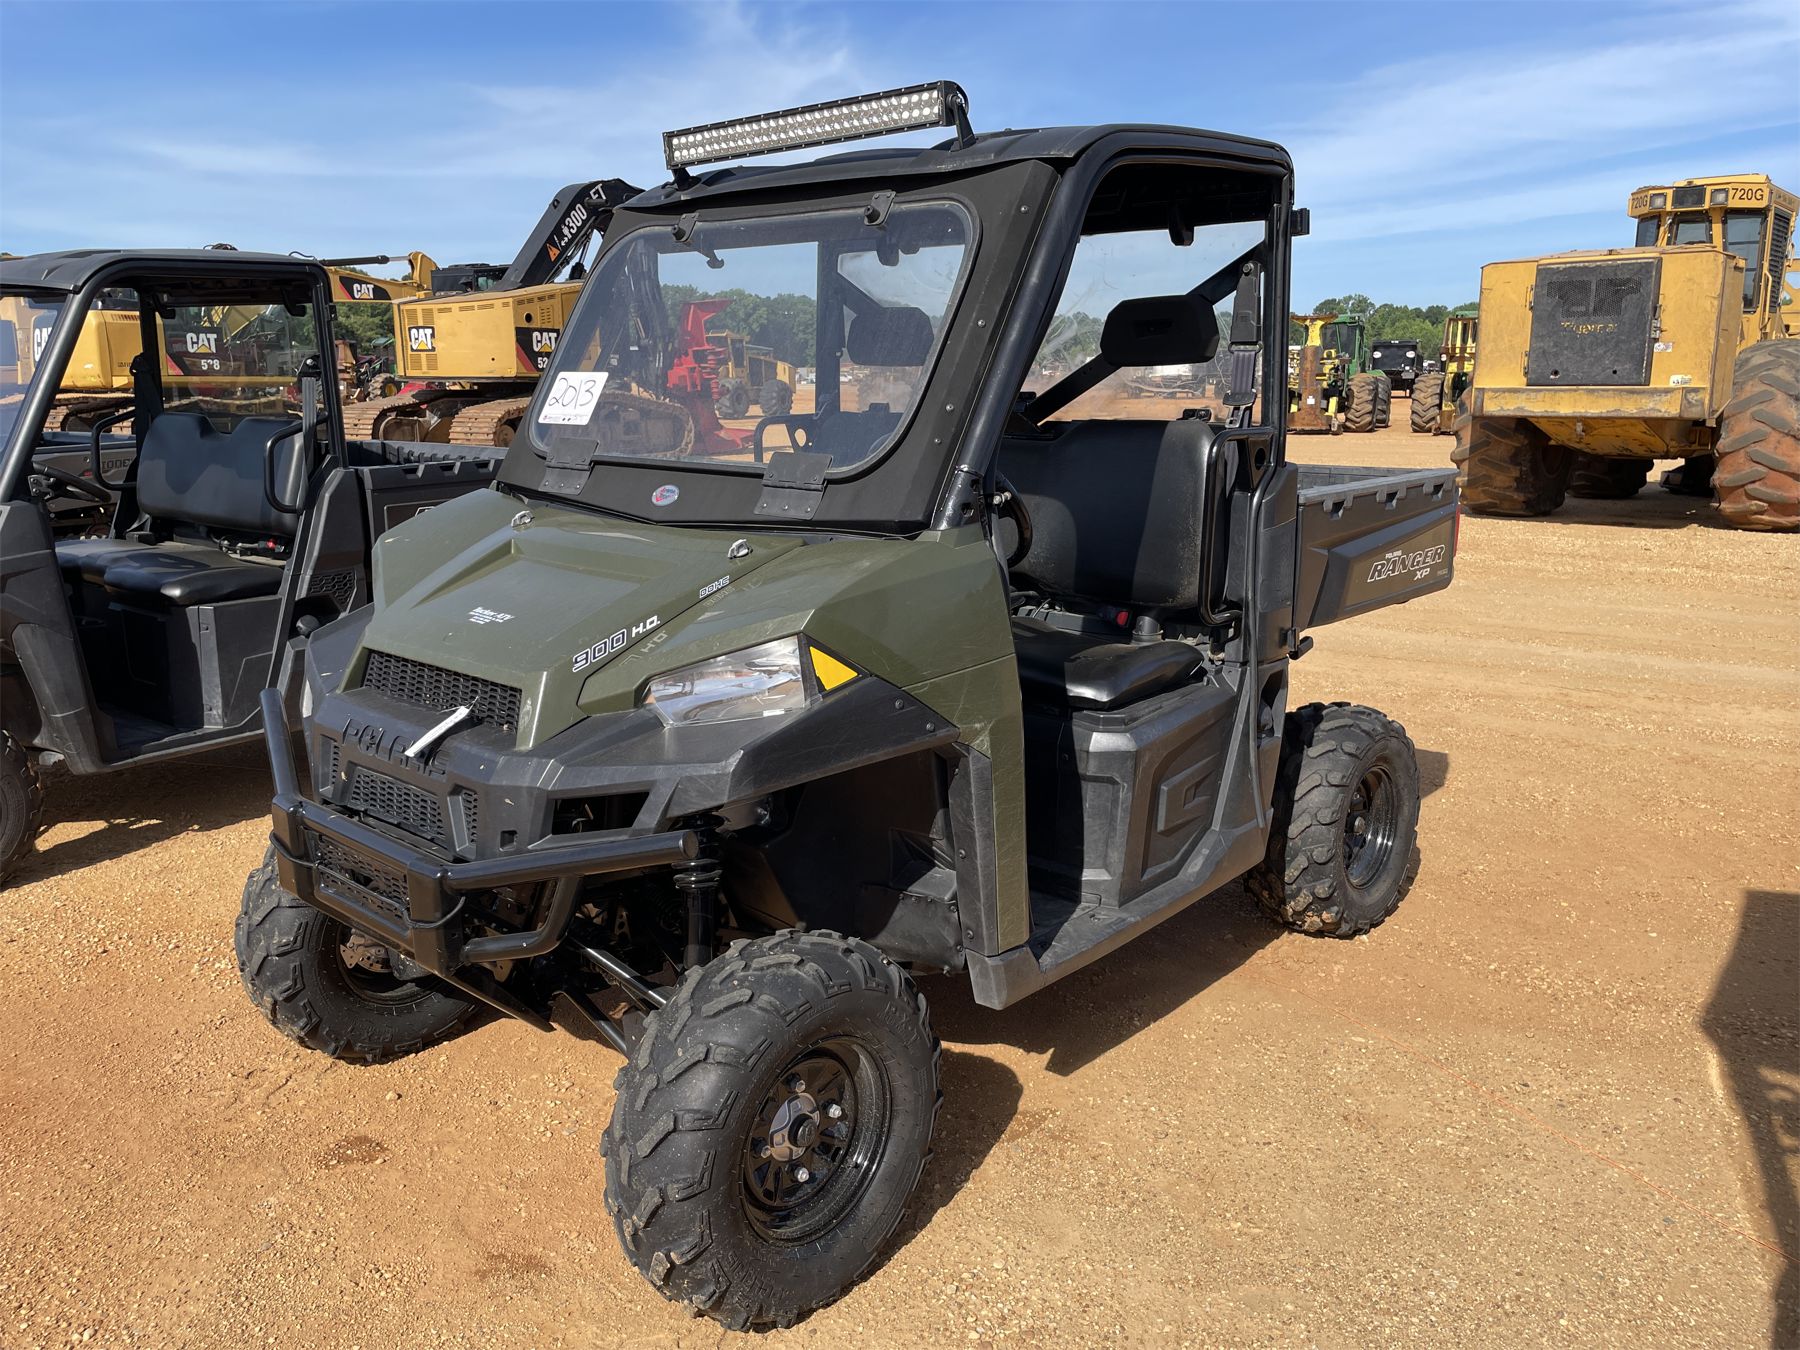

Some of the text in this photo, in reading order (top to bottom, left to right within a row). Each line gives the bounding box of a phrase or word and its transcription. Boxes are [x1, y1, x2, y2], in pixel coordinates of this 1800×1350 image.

[1631, 195, 1648, 209] 720G
[1731, 188, 1764, 201] 720G
[565, 203, 587, 234] 300
[353, 283, 375, 299] CAT
[186, 332, 218, 353] CAT
[410, 328, 433, 350] CAT
[532, 331, 558, 353] CAT
[548, 377, 597, 410] 2013
[1367, 544, 1446, 583] RANGER
[1414, 567, 1431, 581] XP
[699, 575, 730, 599] DOHC
[572, 615, 661, 673] 900 H.O.
